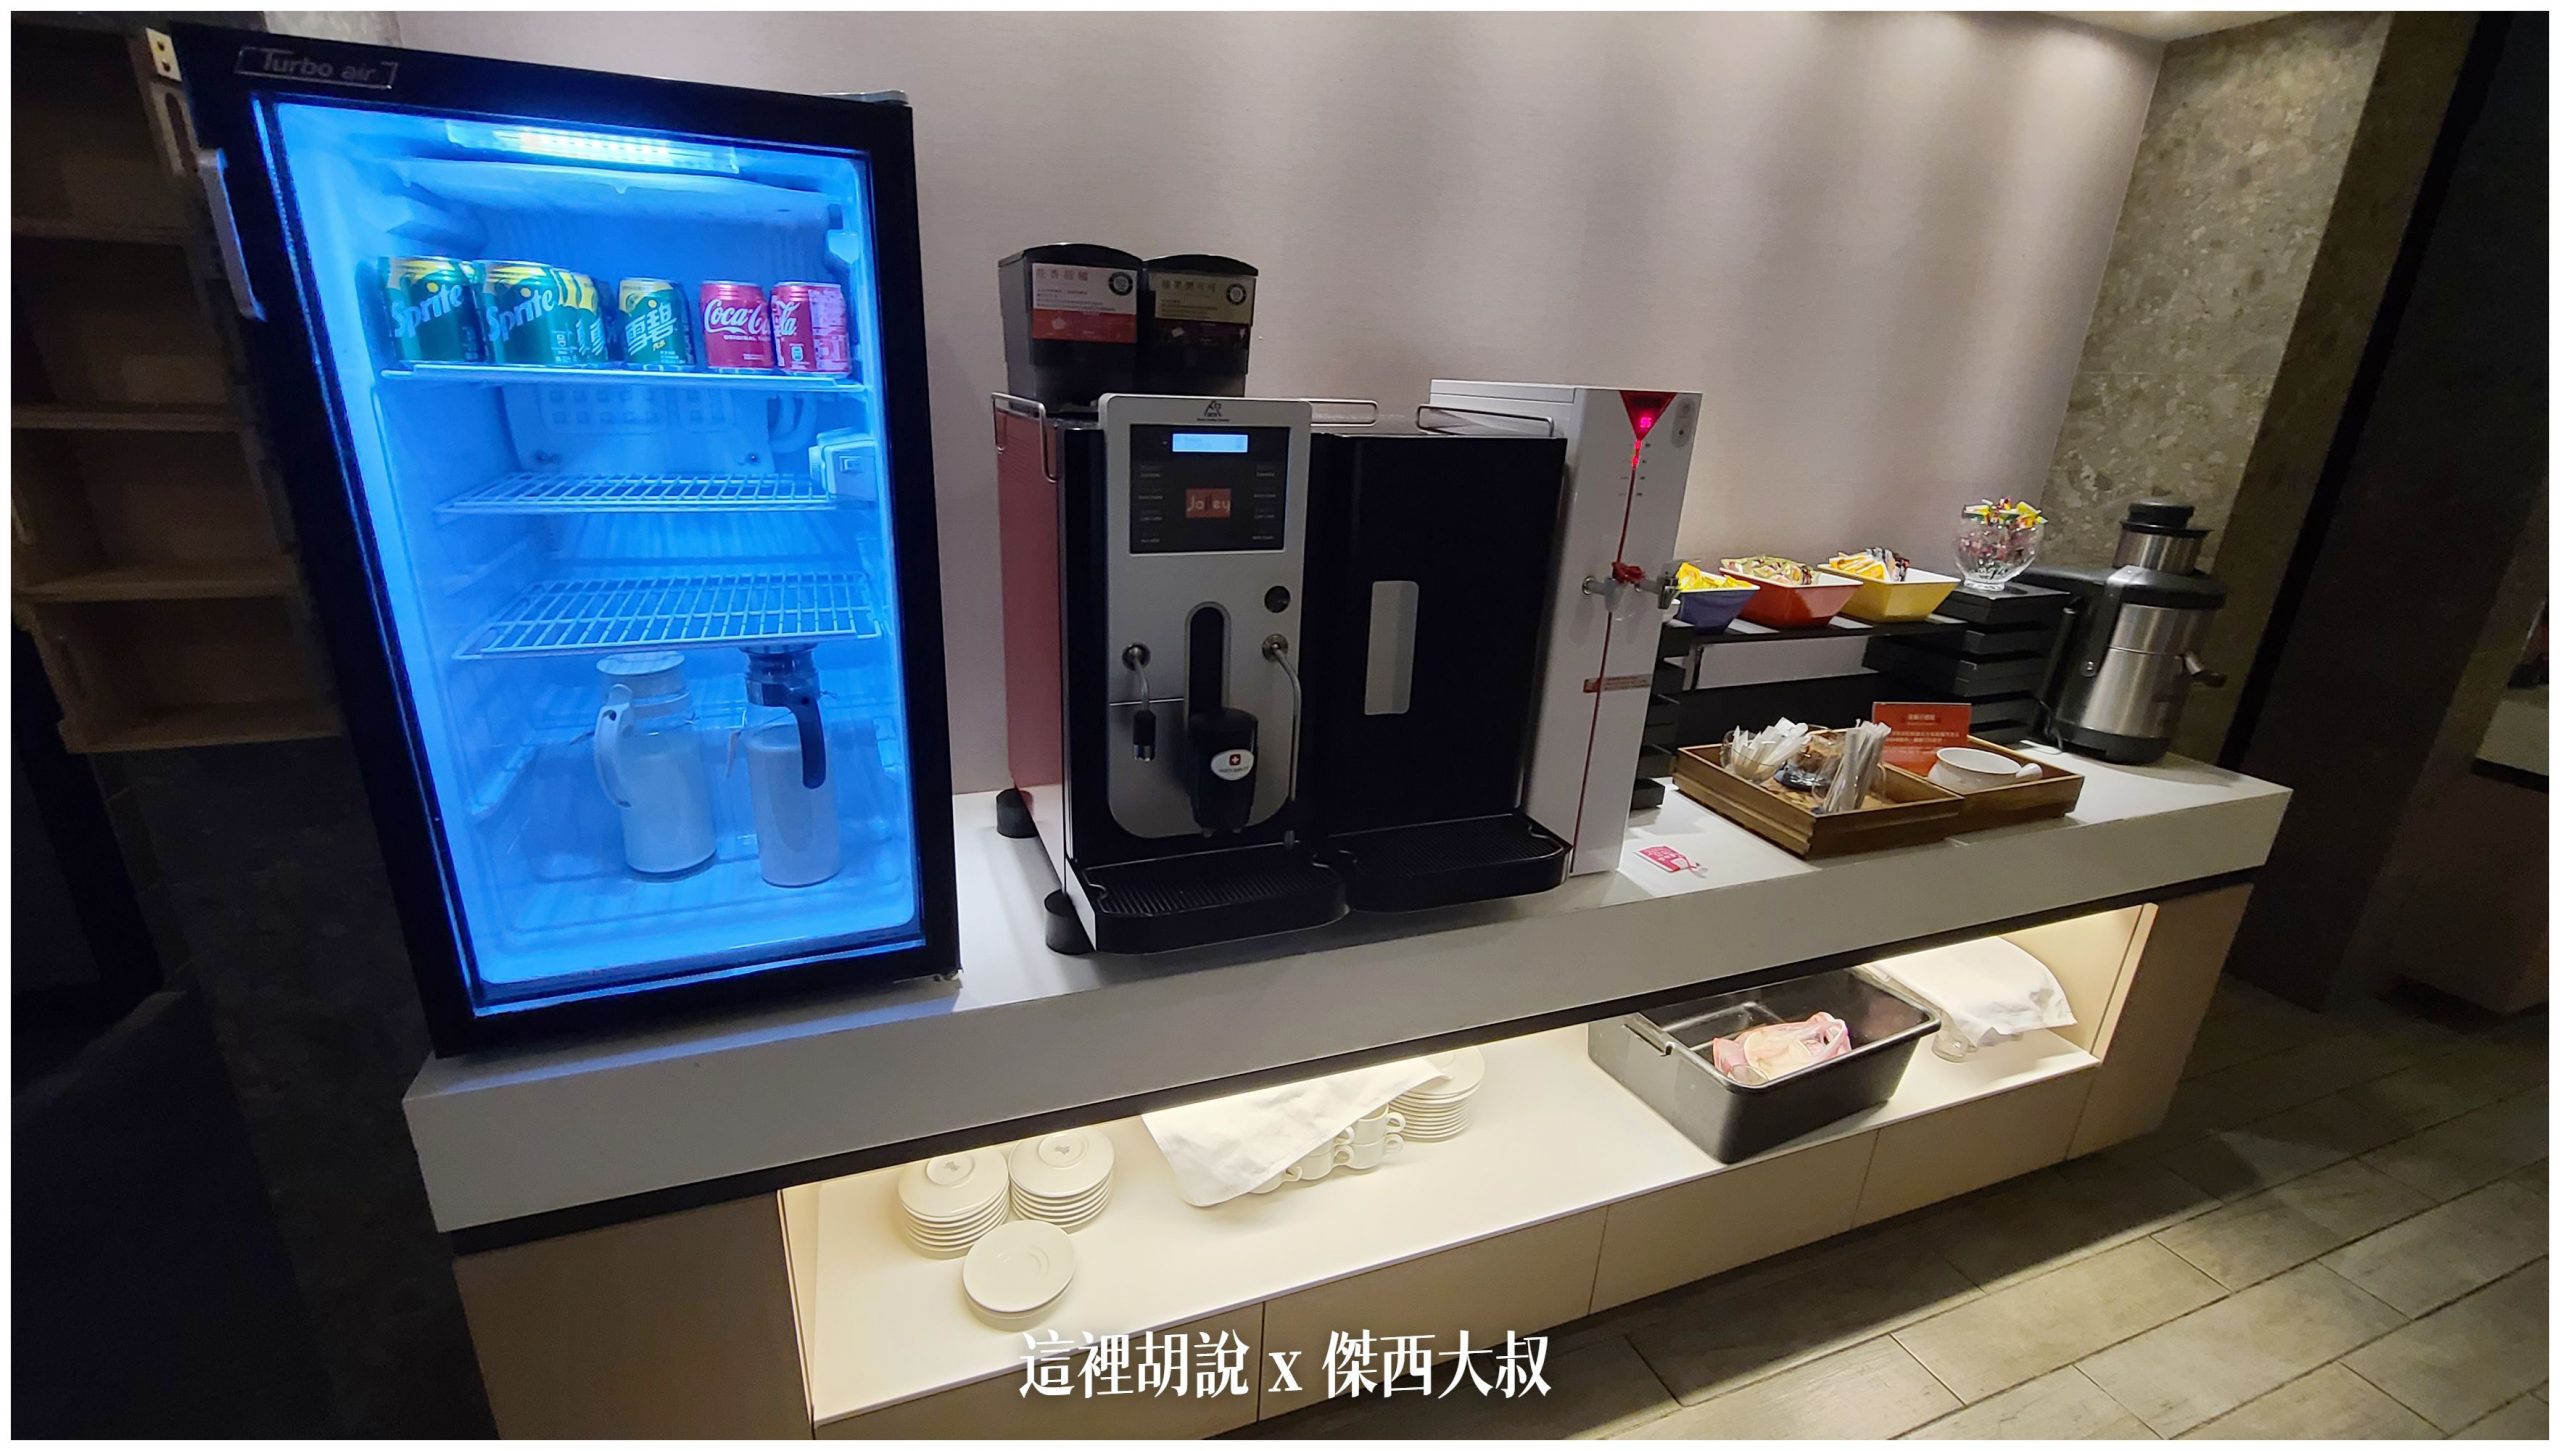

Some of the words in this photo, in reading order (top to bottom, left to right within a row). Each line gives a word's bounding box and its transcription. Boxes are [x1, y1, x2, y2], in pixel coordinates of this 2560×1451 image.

[261, 48, 333, 78] Turbo
[341, 63, 377, 81] air
[391, 282, 464, 338] Sprite
[486, 287, 555, 342] Sprite
[625, 300, 677, 356] 雪碧
